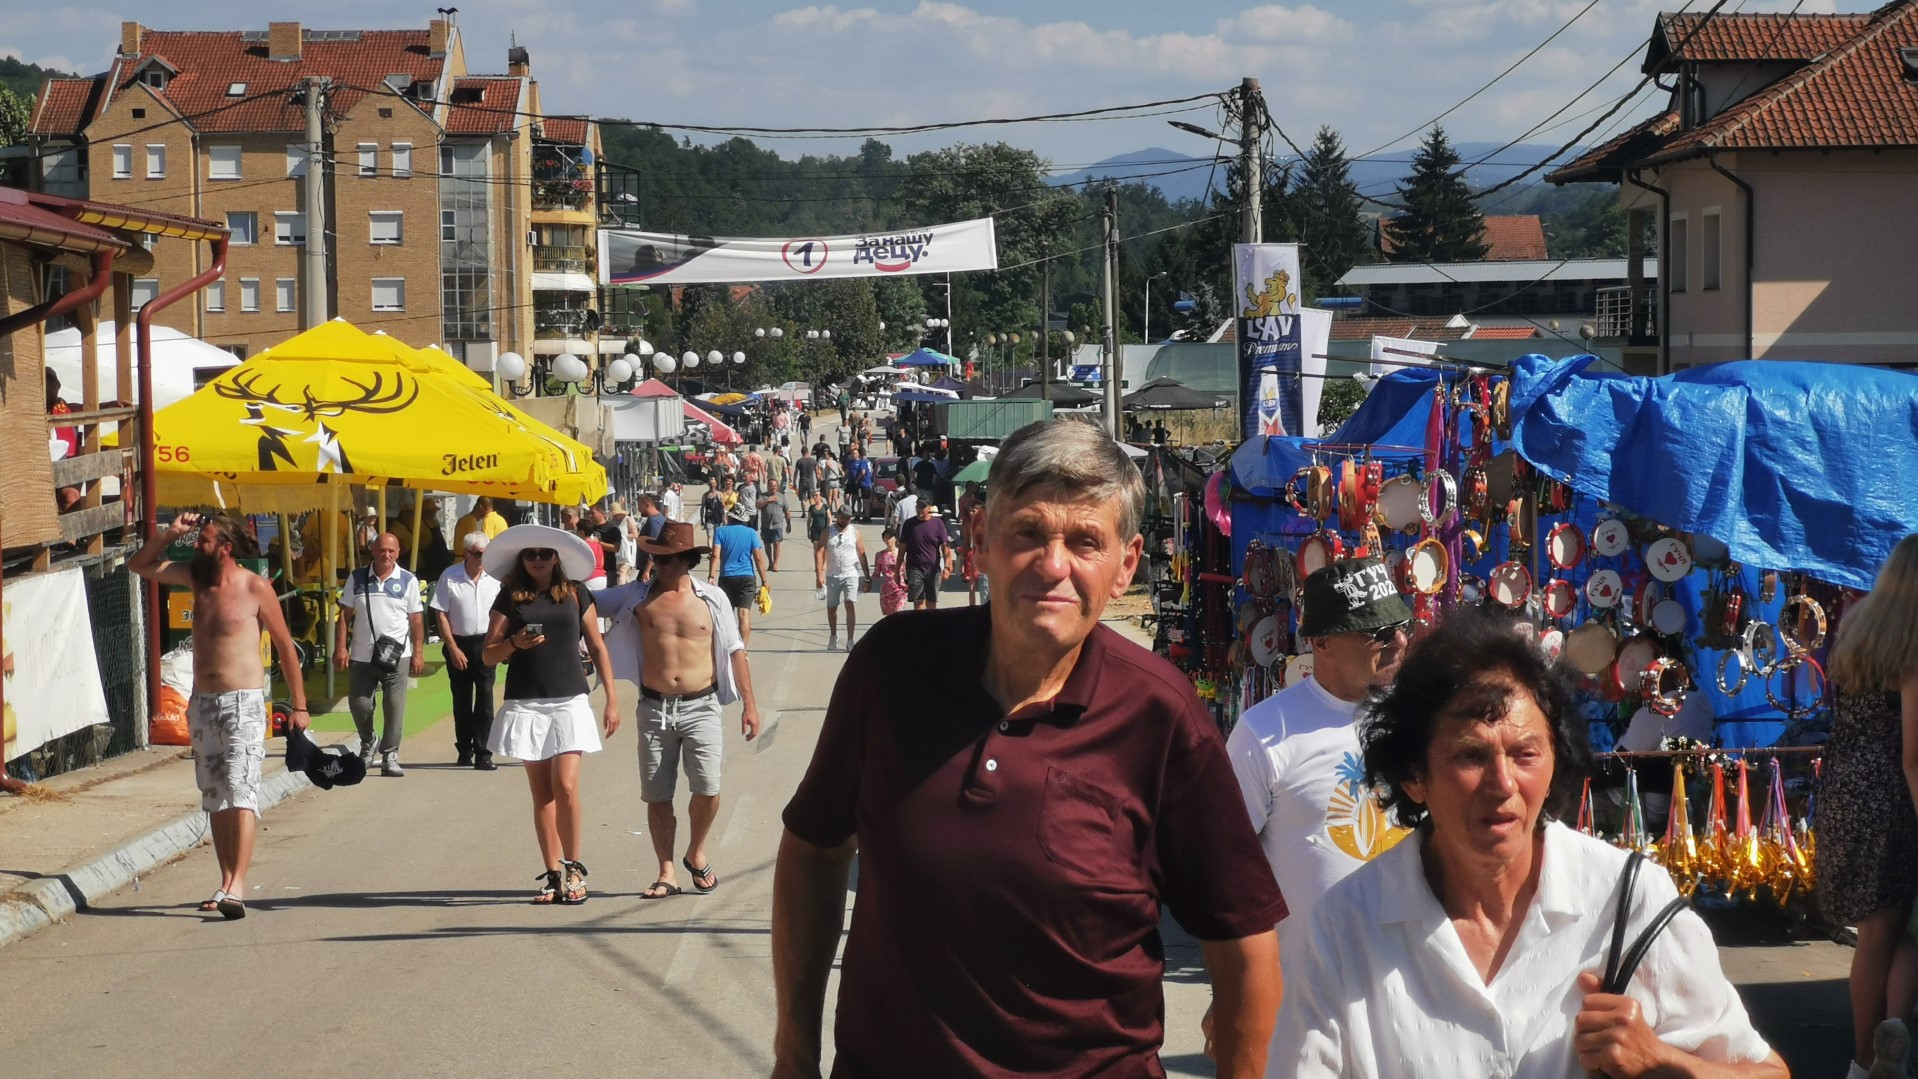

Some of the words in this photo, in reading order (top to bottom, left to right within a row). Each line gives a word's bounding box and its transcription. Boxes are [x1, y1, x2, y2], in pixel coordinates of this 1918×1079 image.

[882, 233, 934, 246] нашу
[793, 242, 815, 267] 1
[854, 244, 929, 264] децу.
[1242, 340, 1299, 357] Premium
[441, 452, 500, 476] Jelen
[1353, 563, 1389, 588] ГУЧ
[1369, 579, 1398, 601] 202
